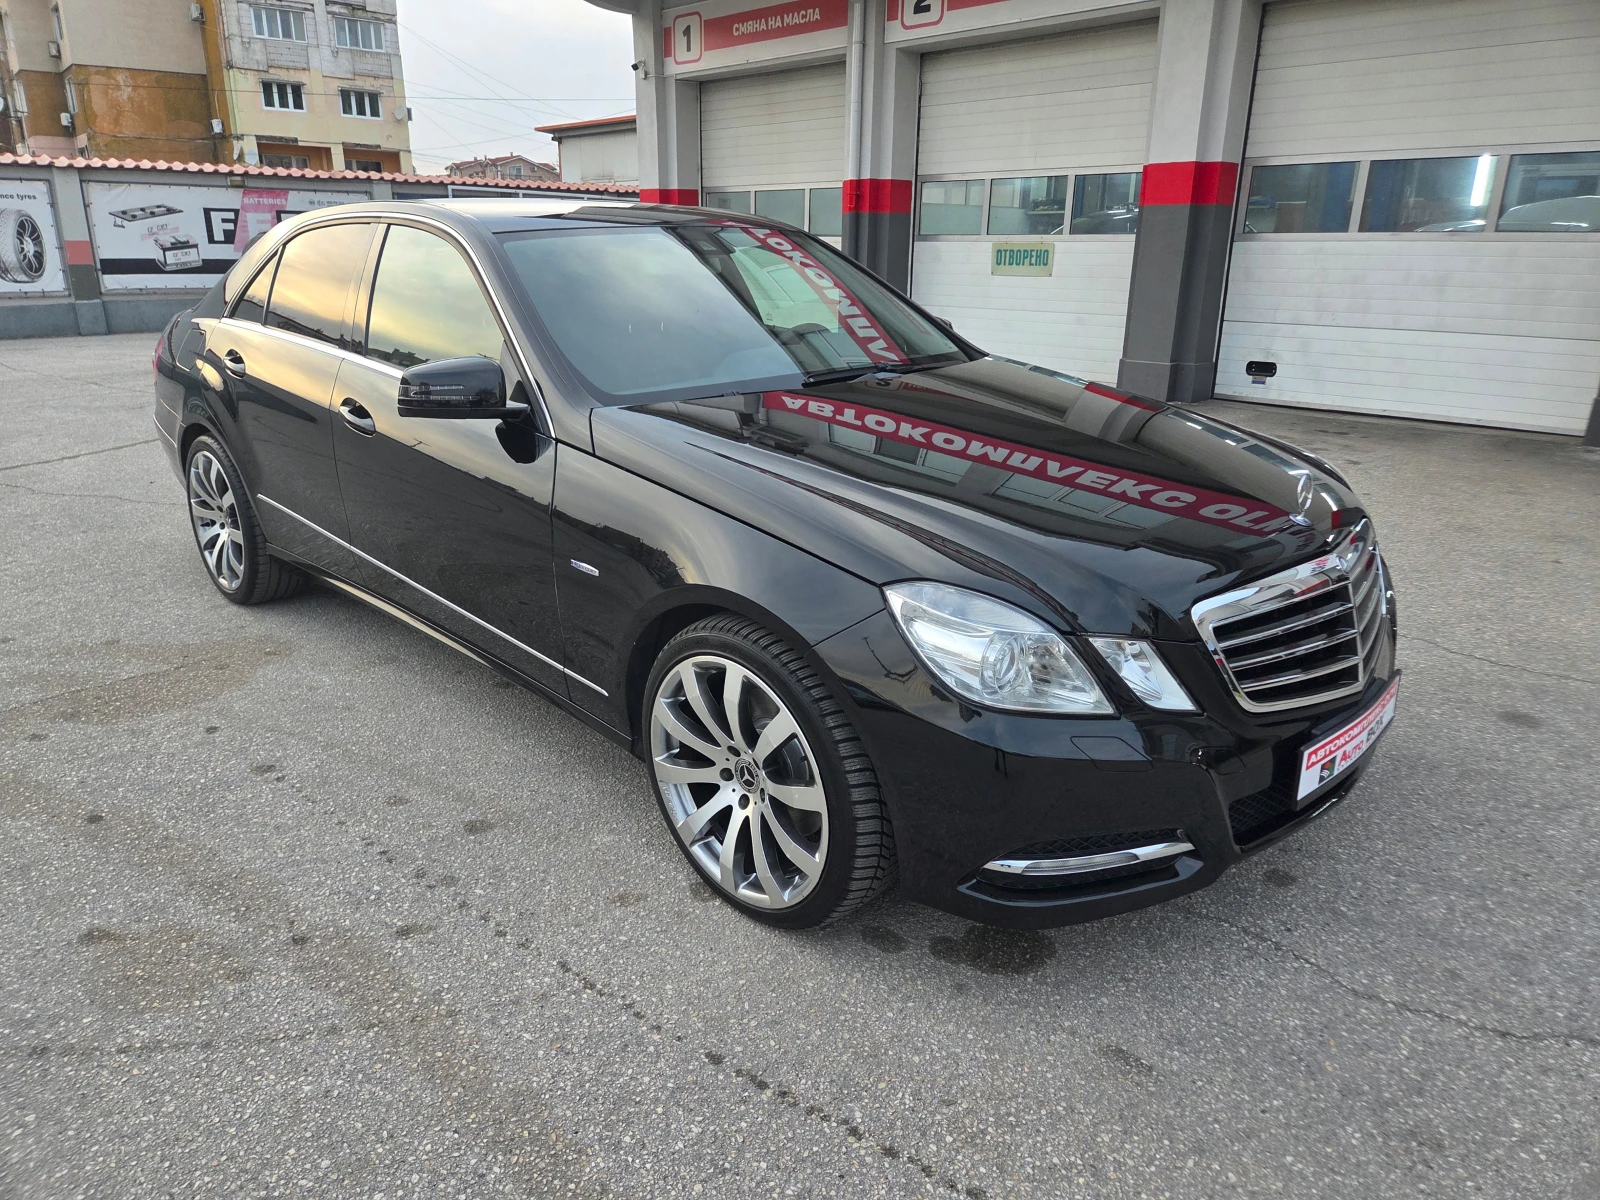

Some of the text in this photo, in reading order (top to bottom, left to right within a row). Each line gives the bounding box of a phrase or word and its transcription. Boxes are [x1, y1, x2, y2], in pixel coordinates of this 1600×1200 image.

[732, 7, 821, 36] СМЯНА НА МАСЛА
[682, 24, 692, 53] 1
[16, 193, 37, 201] tyres
[243, 197, 287, 206] BATTERIES
[995, 248, 1050, 267] ОТВОРЕНО
